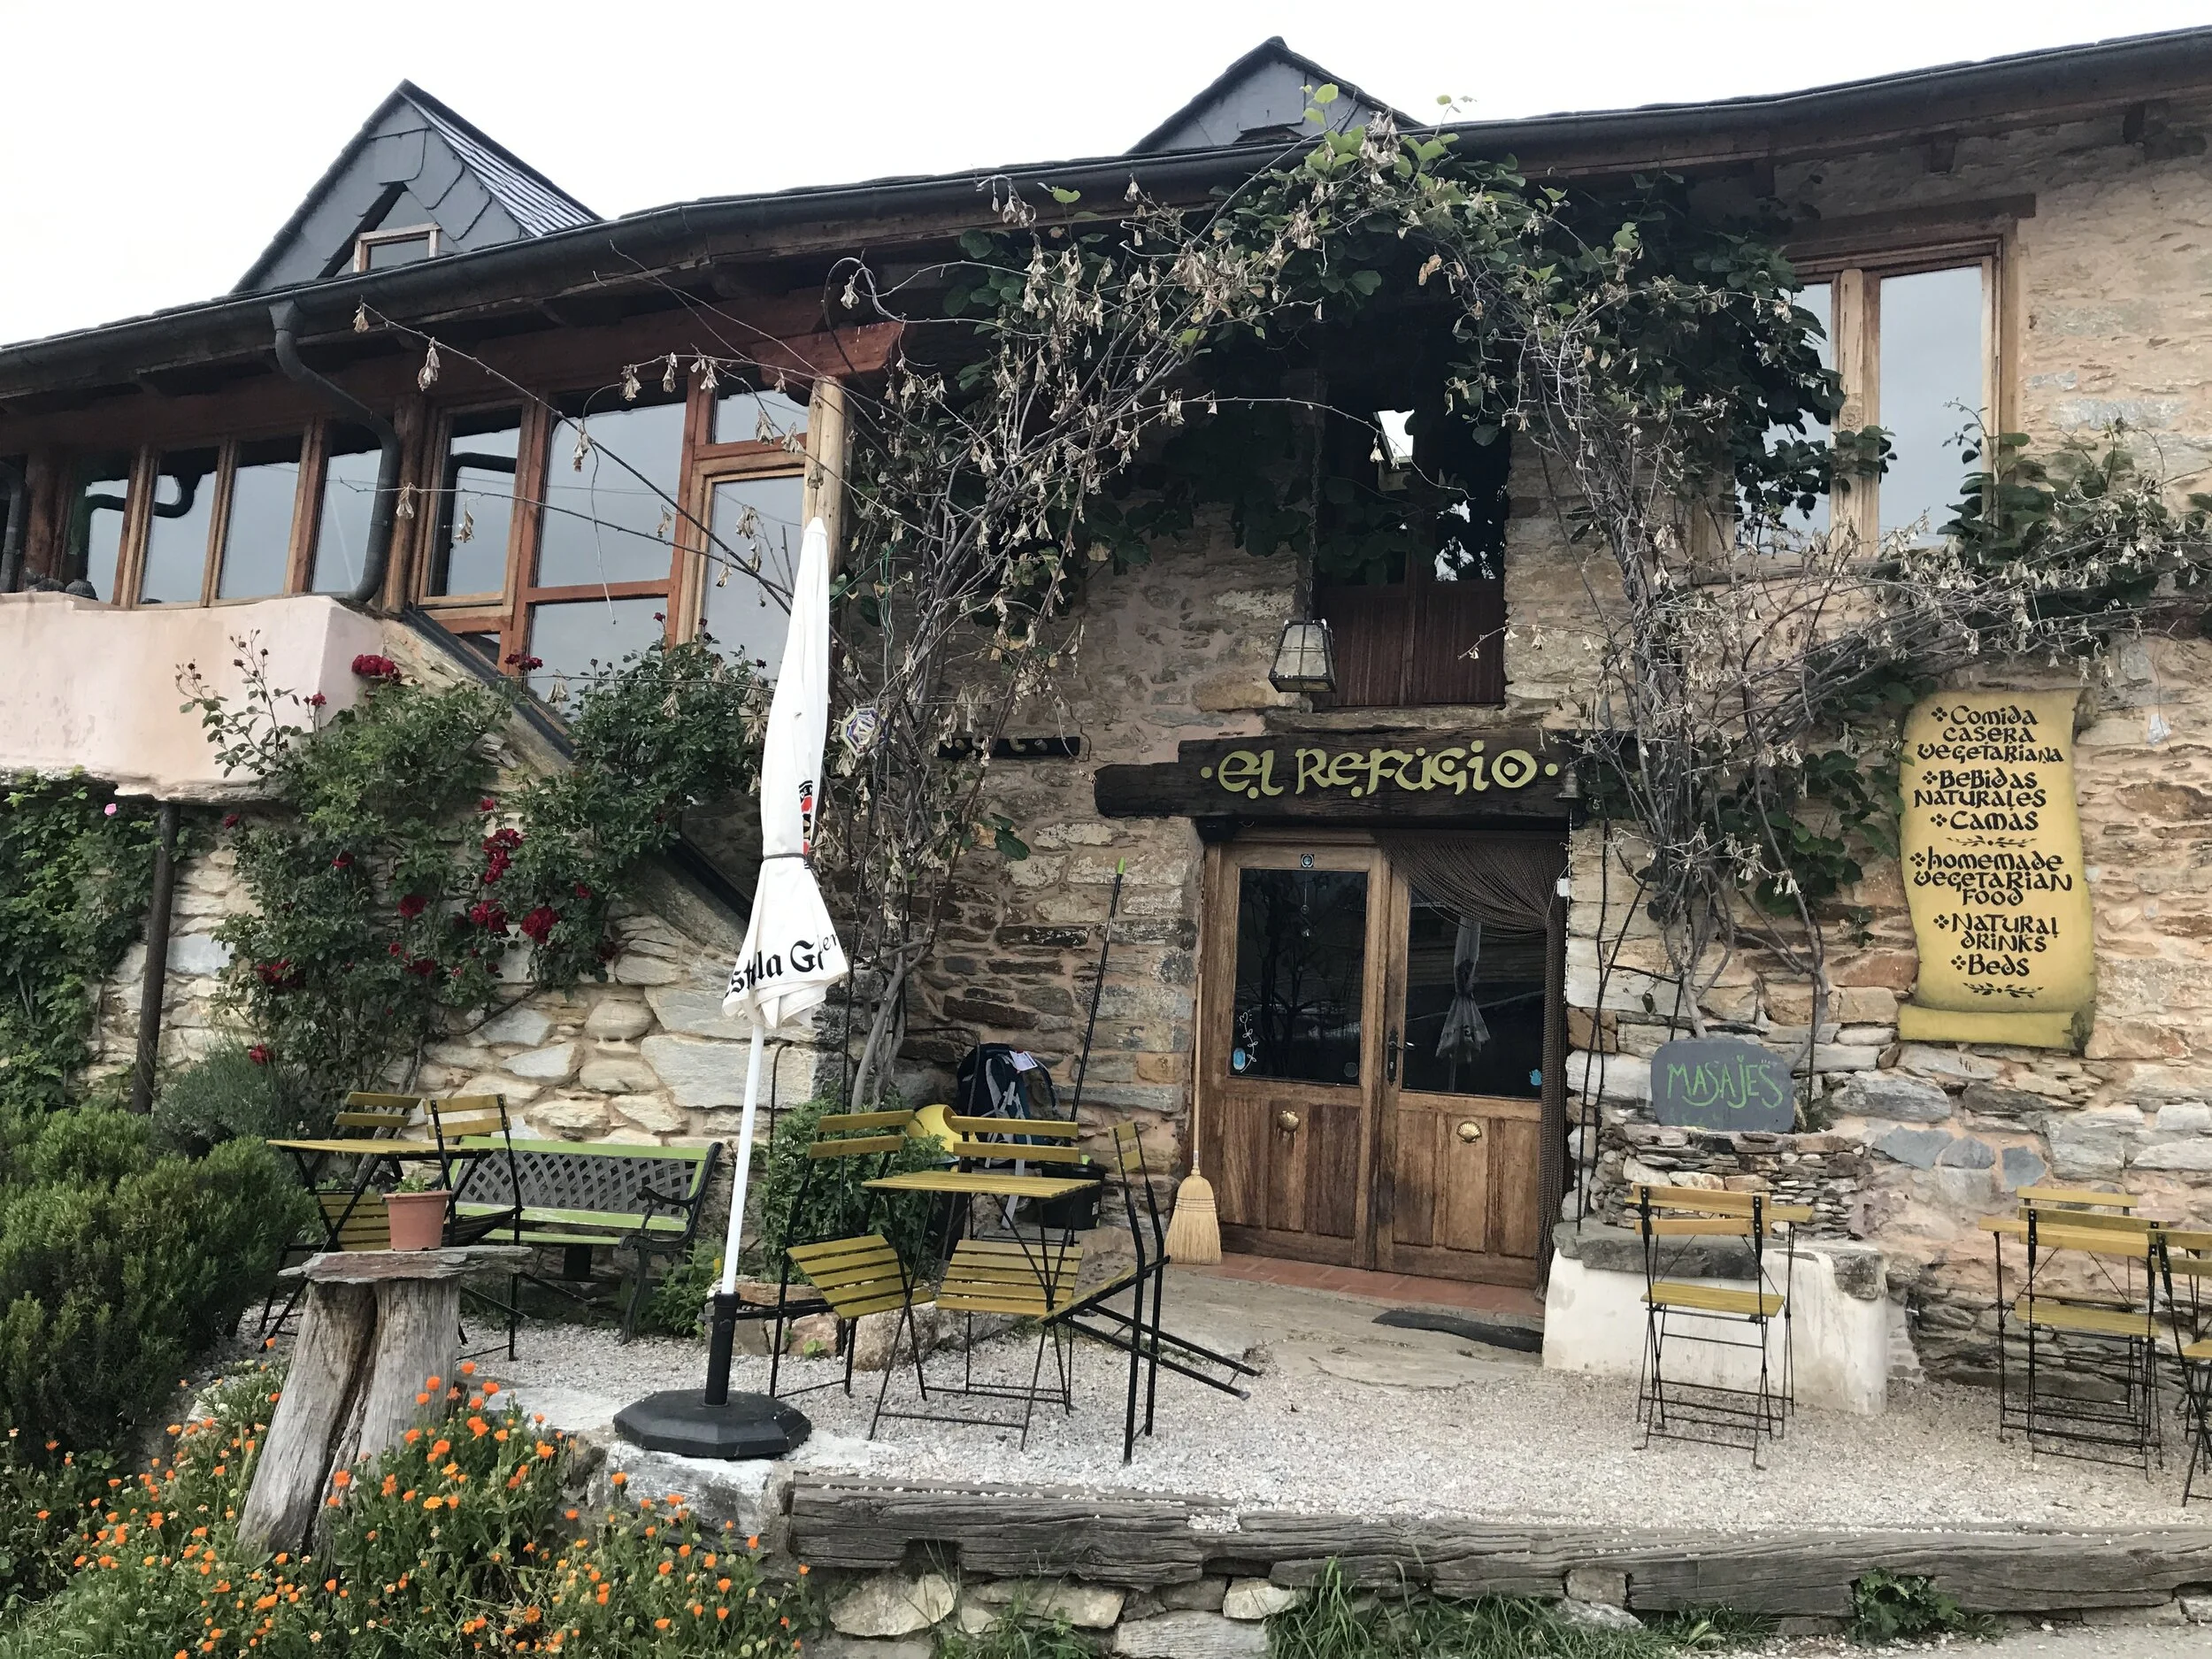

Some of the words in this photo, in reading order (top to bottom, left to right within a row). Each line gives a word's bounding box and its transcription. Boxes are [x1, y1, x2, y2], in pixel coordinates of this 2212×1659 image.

[1949, 704, 2039, 726] Comida
[1968, 953, 2031, 977] Beds
[1667, 1057, 1784, 1109] MASAJES
